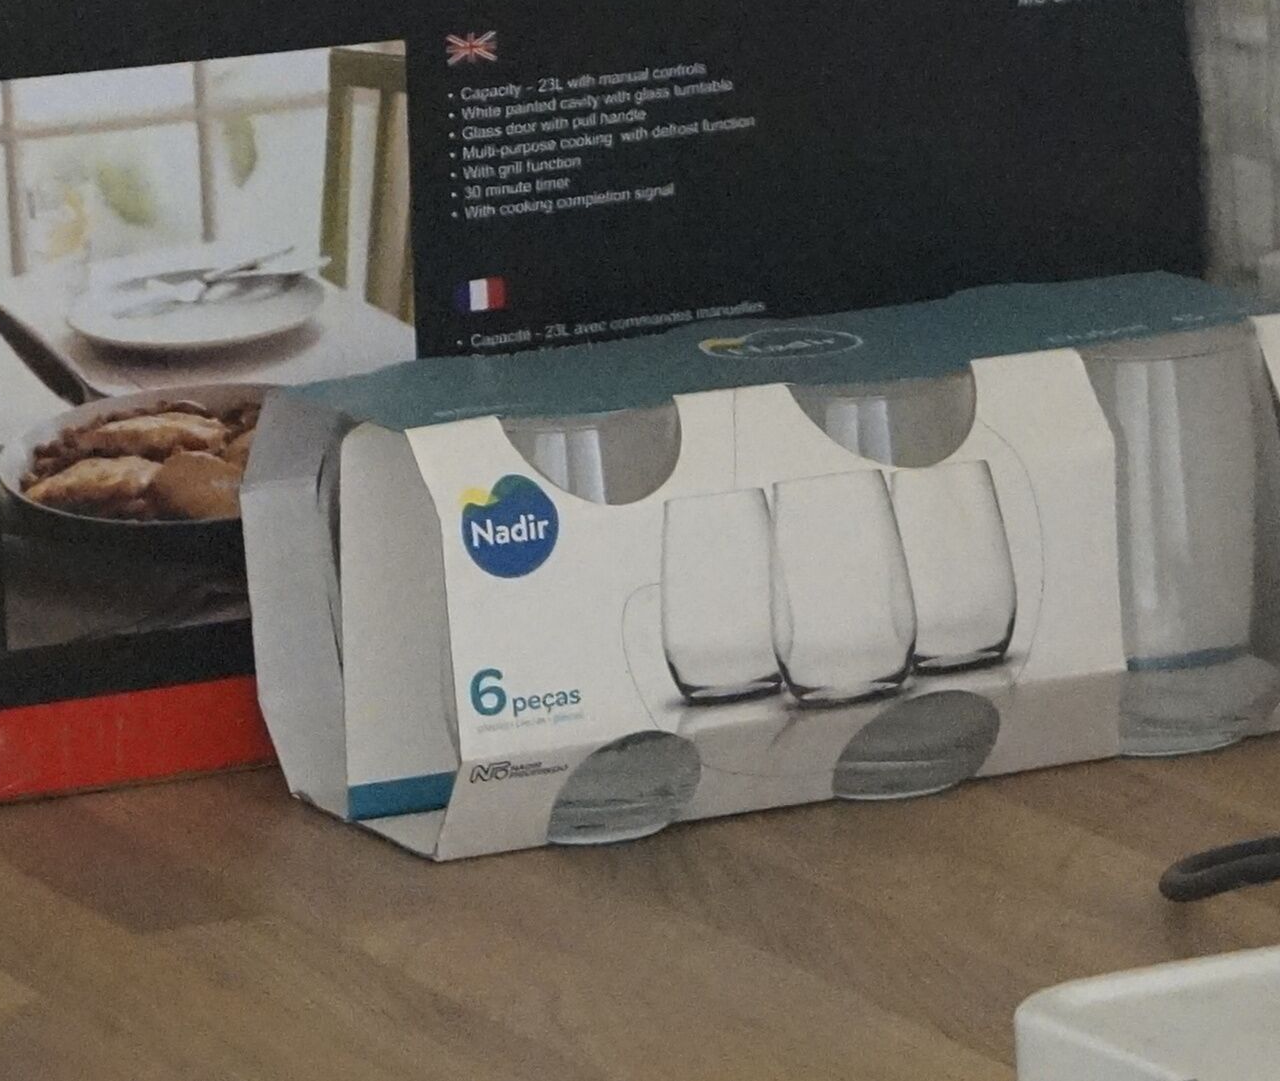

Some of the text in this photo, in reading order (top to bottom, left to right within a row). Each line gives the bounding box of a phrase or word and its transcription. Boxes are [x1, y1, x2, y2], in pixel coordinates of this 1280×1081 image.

[460, 83, 522, 102] Capacity
[538, 77, 564, 93] 23L
[567, 73, 596, 89] with
[599, 67, 650, 86] manual
[652, 62, 708, 80] controls
[461, 78, 734, 120] White painted cavity with glass turntable
[462, 108, 648, 140] Glass door with pull handle
[462, 116, 756, 160] Multi-purpose cooking with defrost function
[463, 156, 583, 180] With grill function
[464, 176, 571, 200] 30 minute timer
[464, 182, 675, 220] With cooking completion signal
[545, 324, 570, 339] 23L
[574, 320, 607, 335] avec
[609, 309, 693, 331] commandes
[696, 300, 766, 320] manuelles
[470, 513, 549, 548] Nadir
[470, 668, 582, 718] 6 peças
